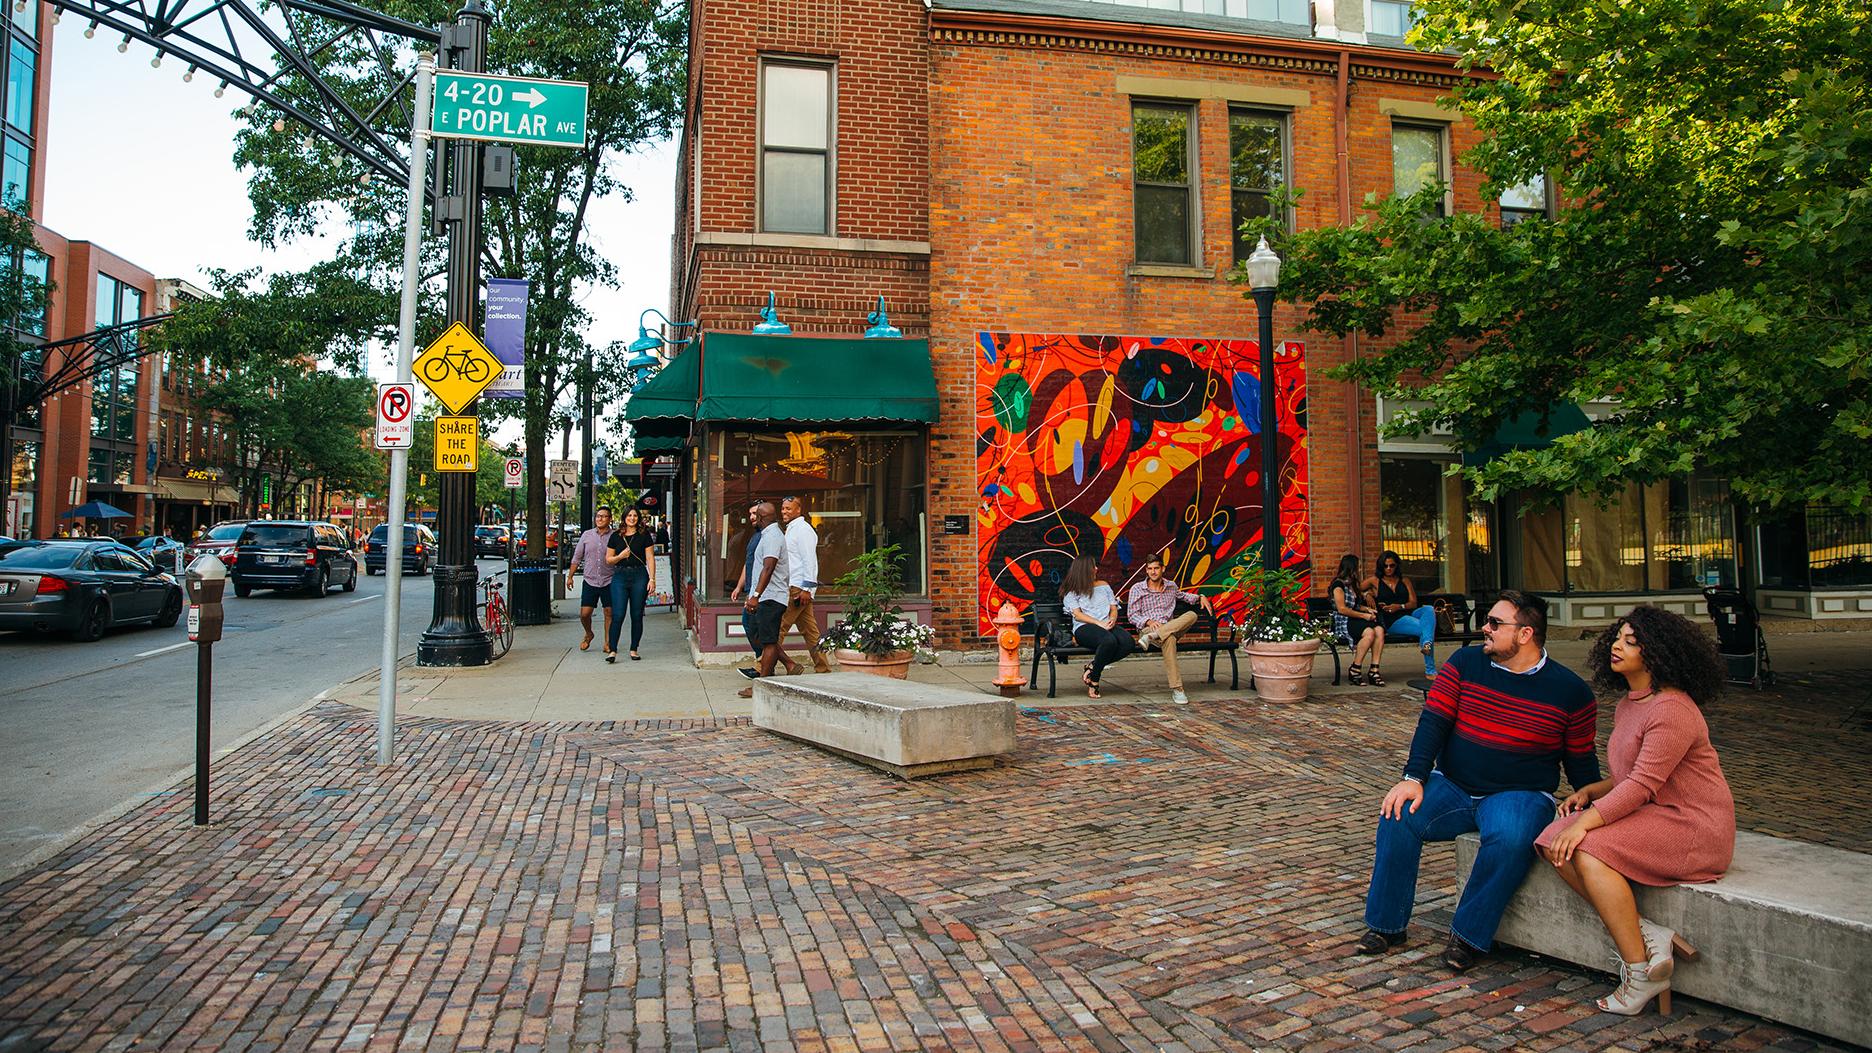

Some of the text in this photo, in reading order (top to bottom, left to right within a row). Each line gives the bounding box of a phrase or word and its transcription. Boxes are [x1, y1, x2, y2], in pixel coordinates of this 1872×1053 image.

[444, 81, 503, 106] 4-20
[442, 108, 577, 137] E POPLAR AVE
[440, 423, 474, 434] SHARE
[447, 438, 466, 449] THE
[442, 454, 470, 464] ROAD
